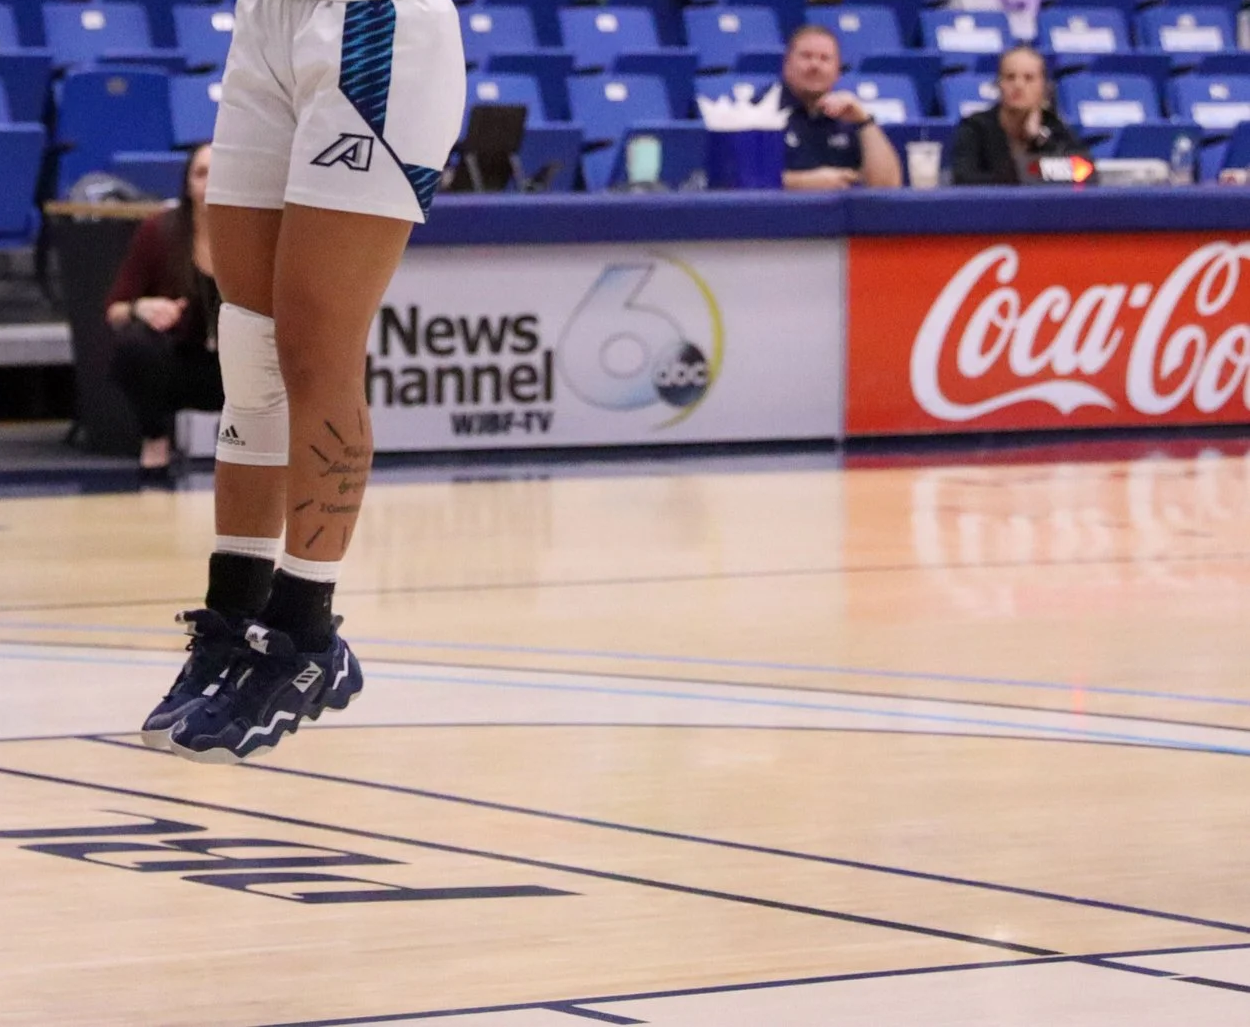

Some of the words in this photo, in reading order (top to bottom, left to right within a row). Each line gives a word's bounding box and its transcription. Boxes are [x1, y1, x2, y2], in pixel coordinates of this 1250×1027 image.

[379, 303, 540, 357] News
[909, 240, 1250, 422] Coca-Co
[364, 351, 556, 407] hannel
